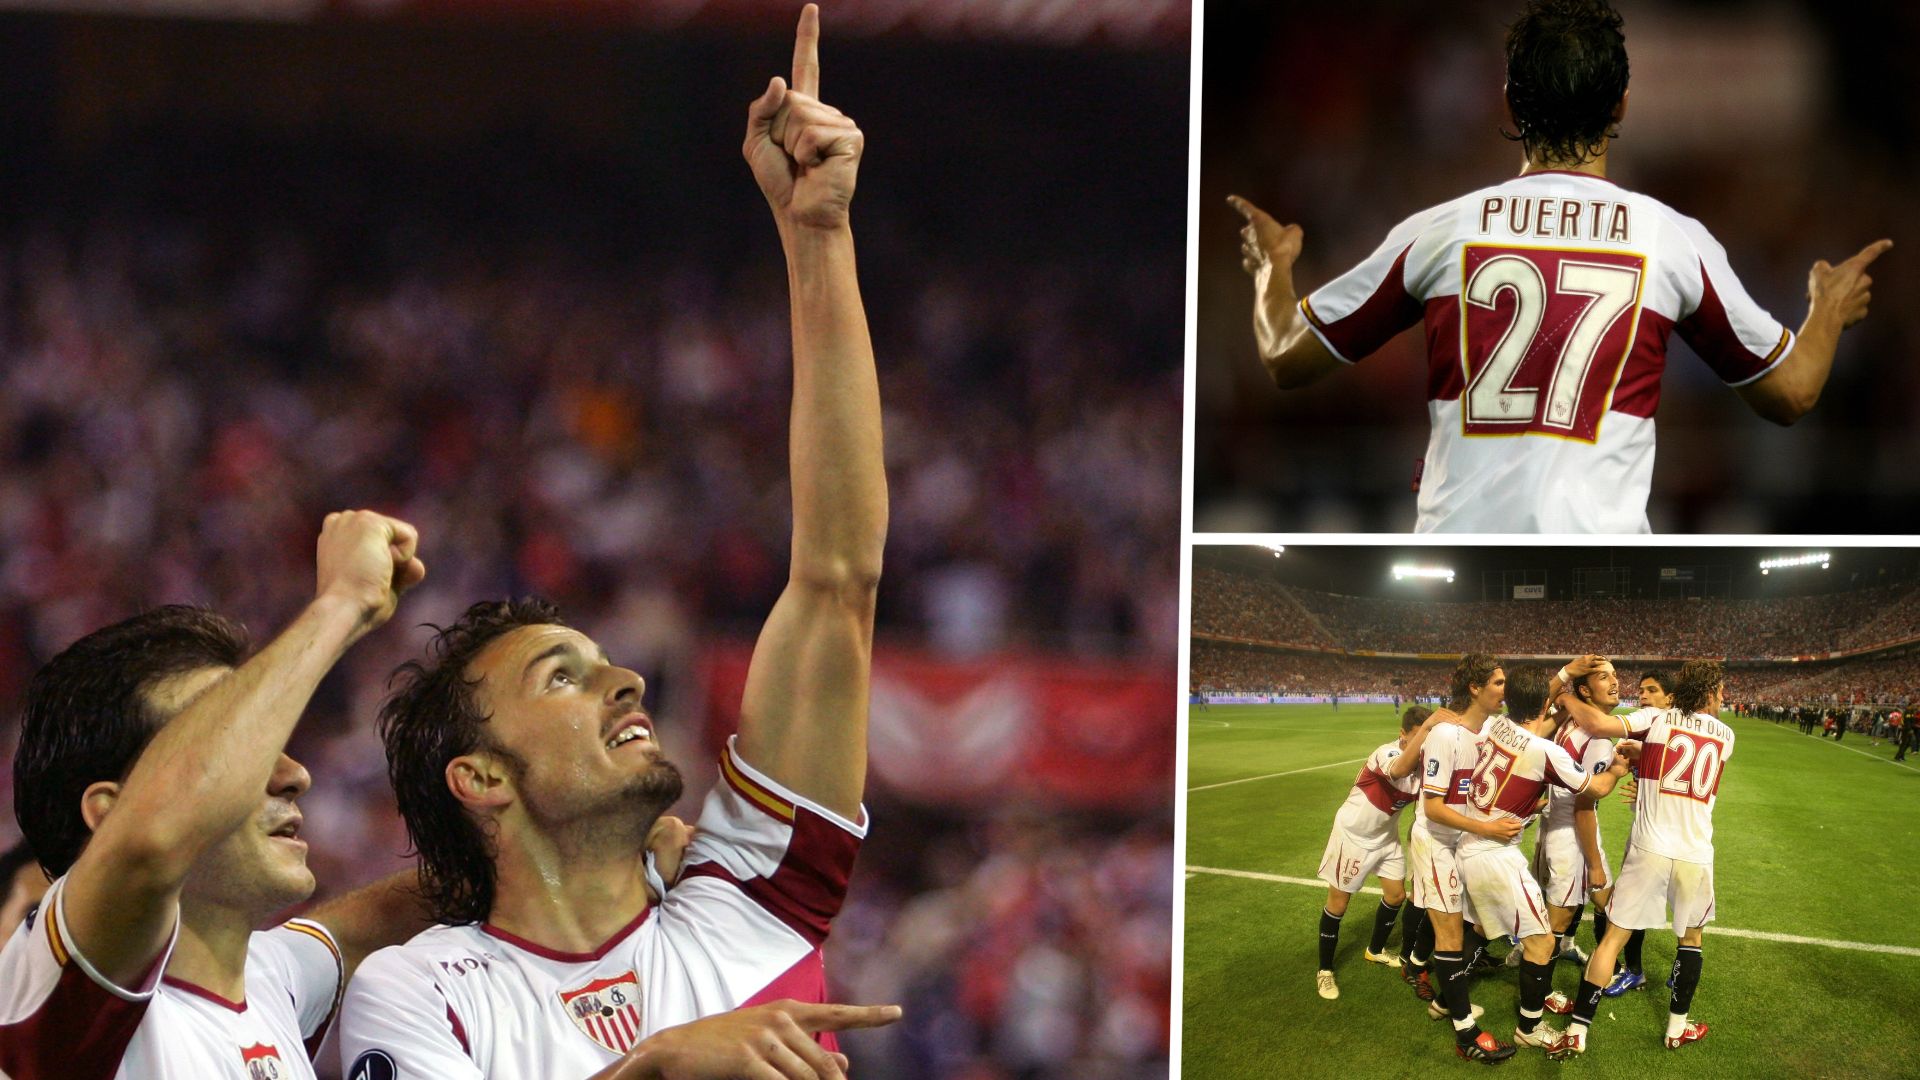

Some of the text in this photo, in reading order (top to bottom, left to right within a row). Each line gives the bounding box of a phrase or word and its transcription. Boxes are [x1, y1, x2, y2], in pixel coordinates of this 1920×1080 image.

[1479, 196, 1632, 244] PUERTA
[1465, 254, 1641, 430] 27
[1661, 734, 1719, 799] 20
[1343, 858, 1361, 877] 15
[1448, 868, 1458, 889] 6
